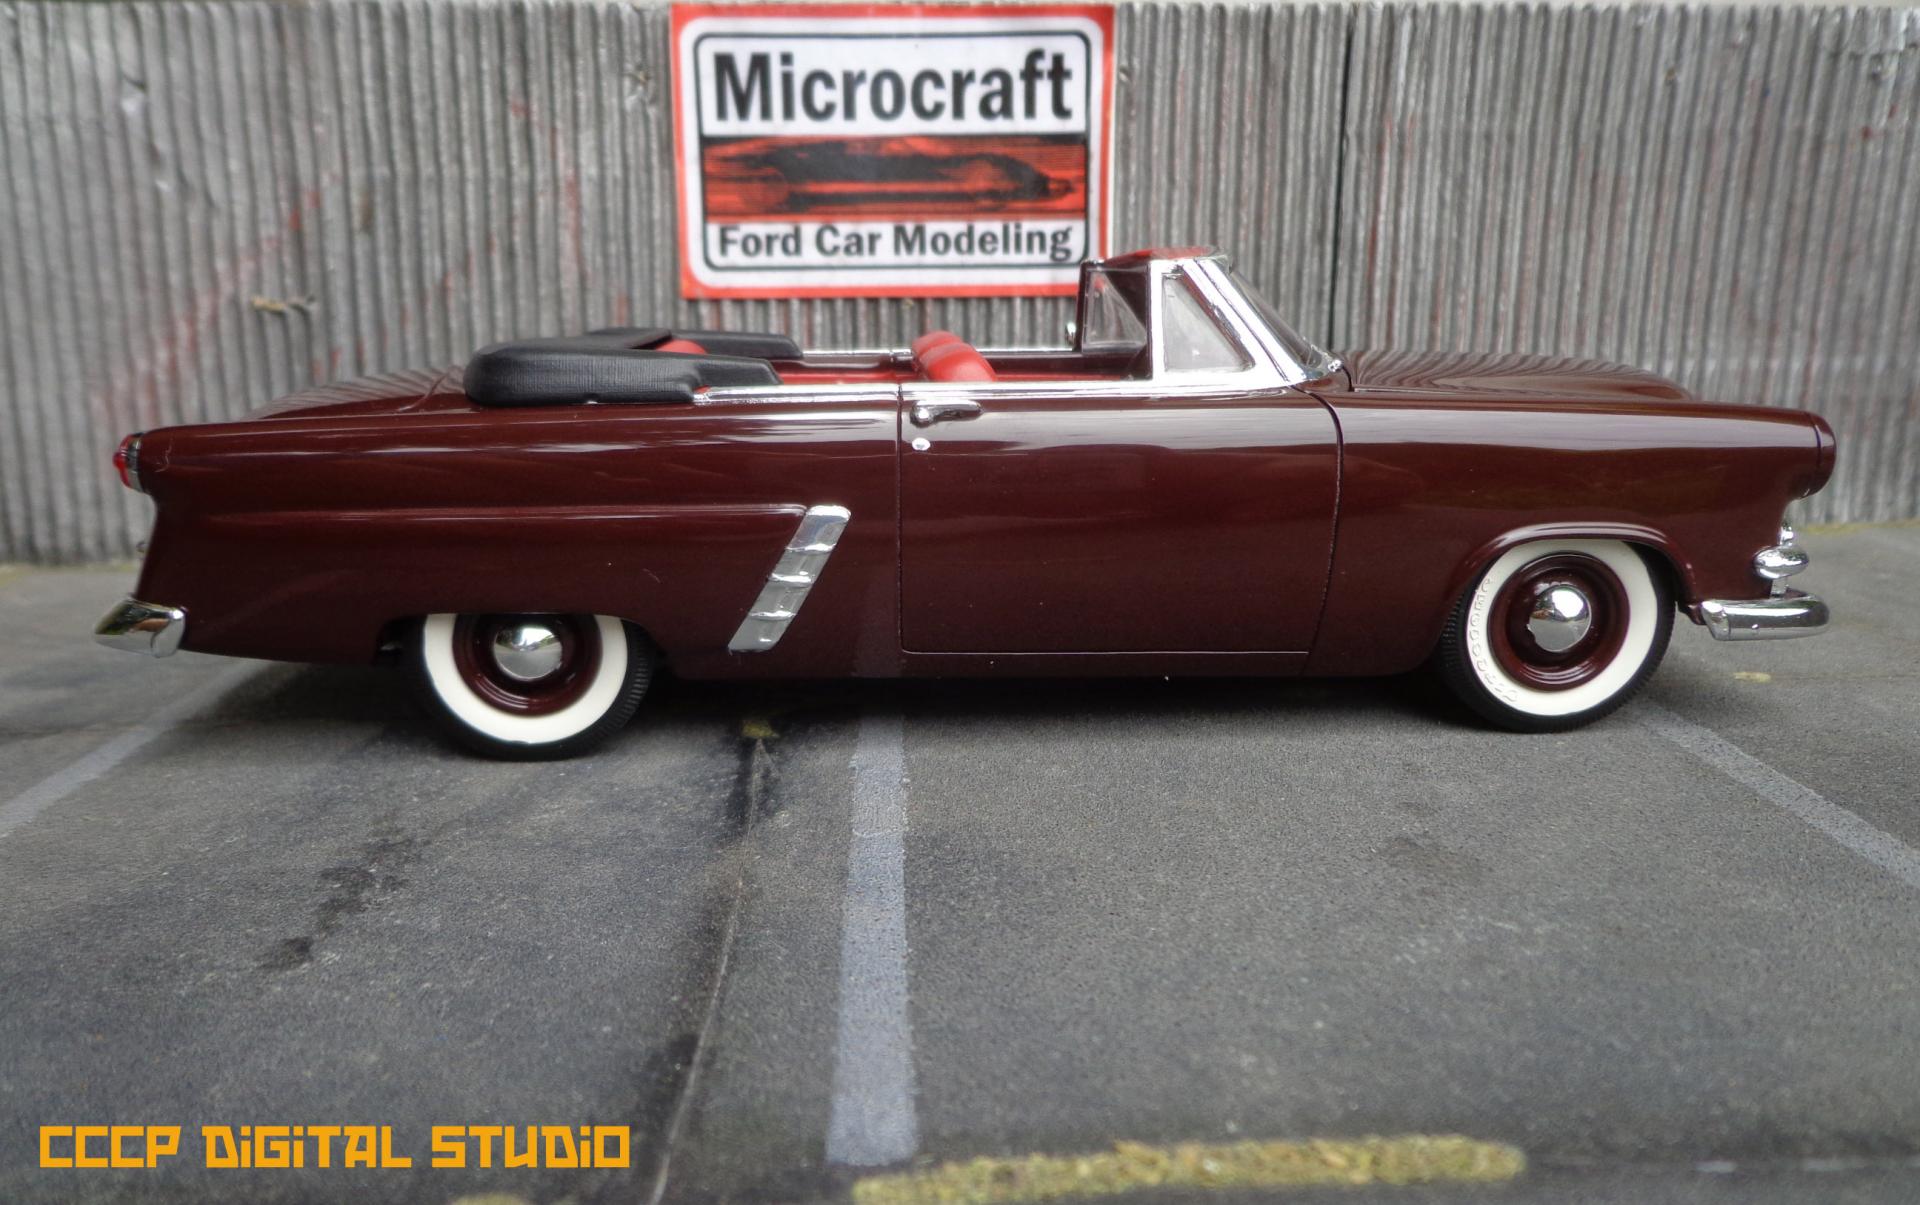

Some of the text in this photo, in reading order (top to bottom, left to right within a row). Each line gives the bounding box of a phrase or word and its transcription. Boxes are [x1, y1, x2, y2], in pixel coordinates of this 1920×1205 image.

[713, 48, 1073, 121] Microcraft
[718, 222, 1073, 262] Ford Car Modeling
